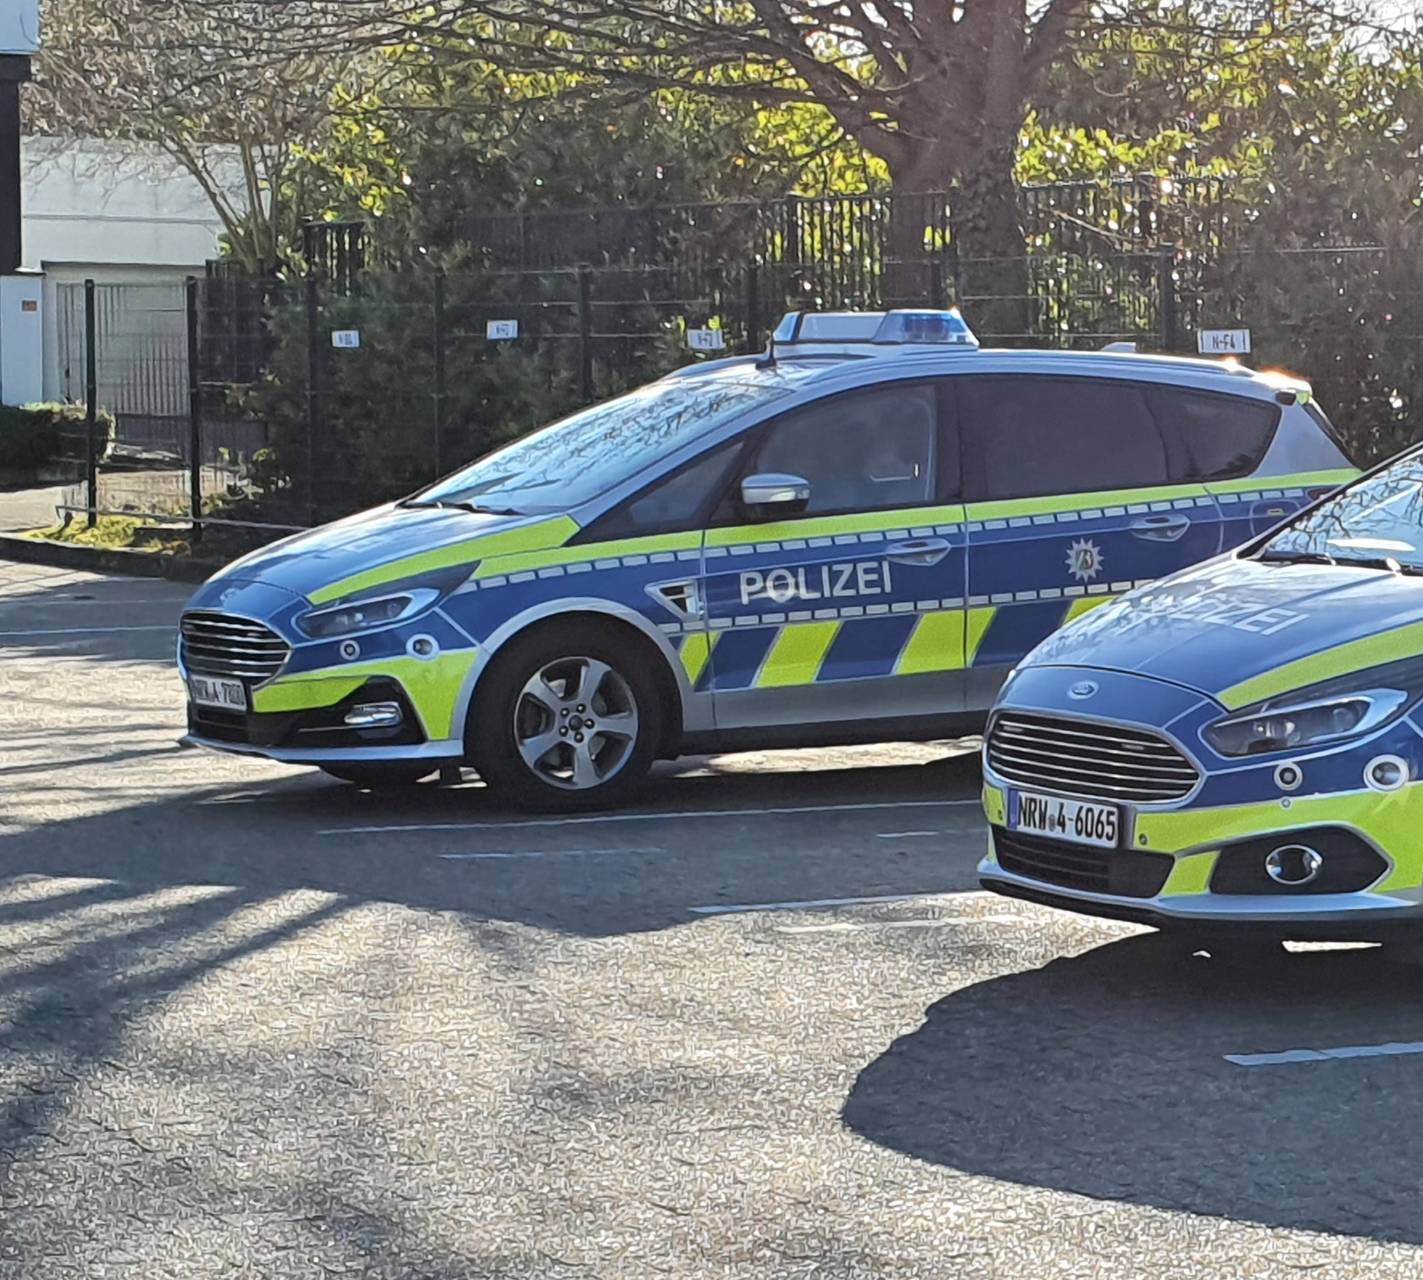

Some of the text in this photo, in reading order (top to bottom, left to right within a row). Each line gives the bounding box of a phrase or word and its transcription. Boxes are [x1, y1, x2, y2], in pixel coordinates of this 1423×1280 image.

[740, 561, 892, 605] POLIZEI
[1018, 796, 1116, 841] NRW 4-6065
